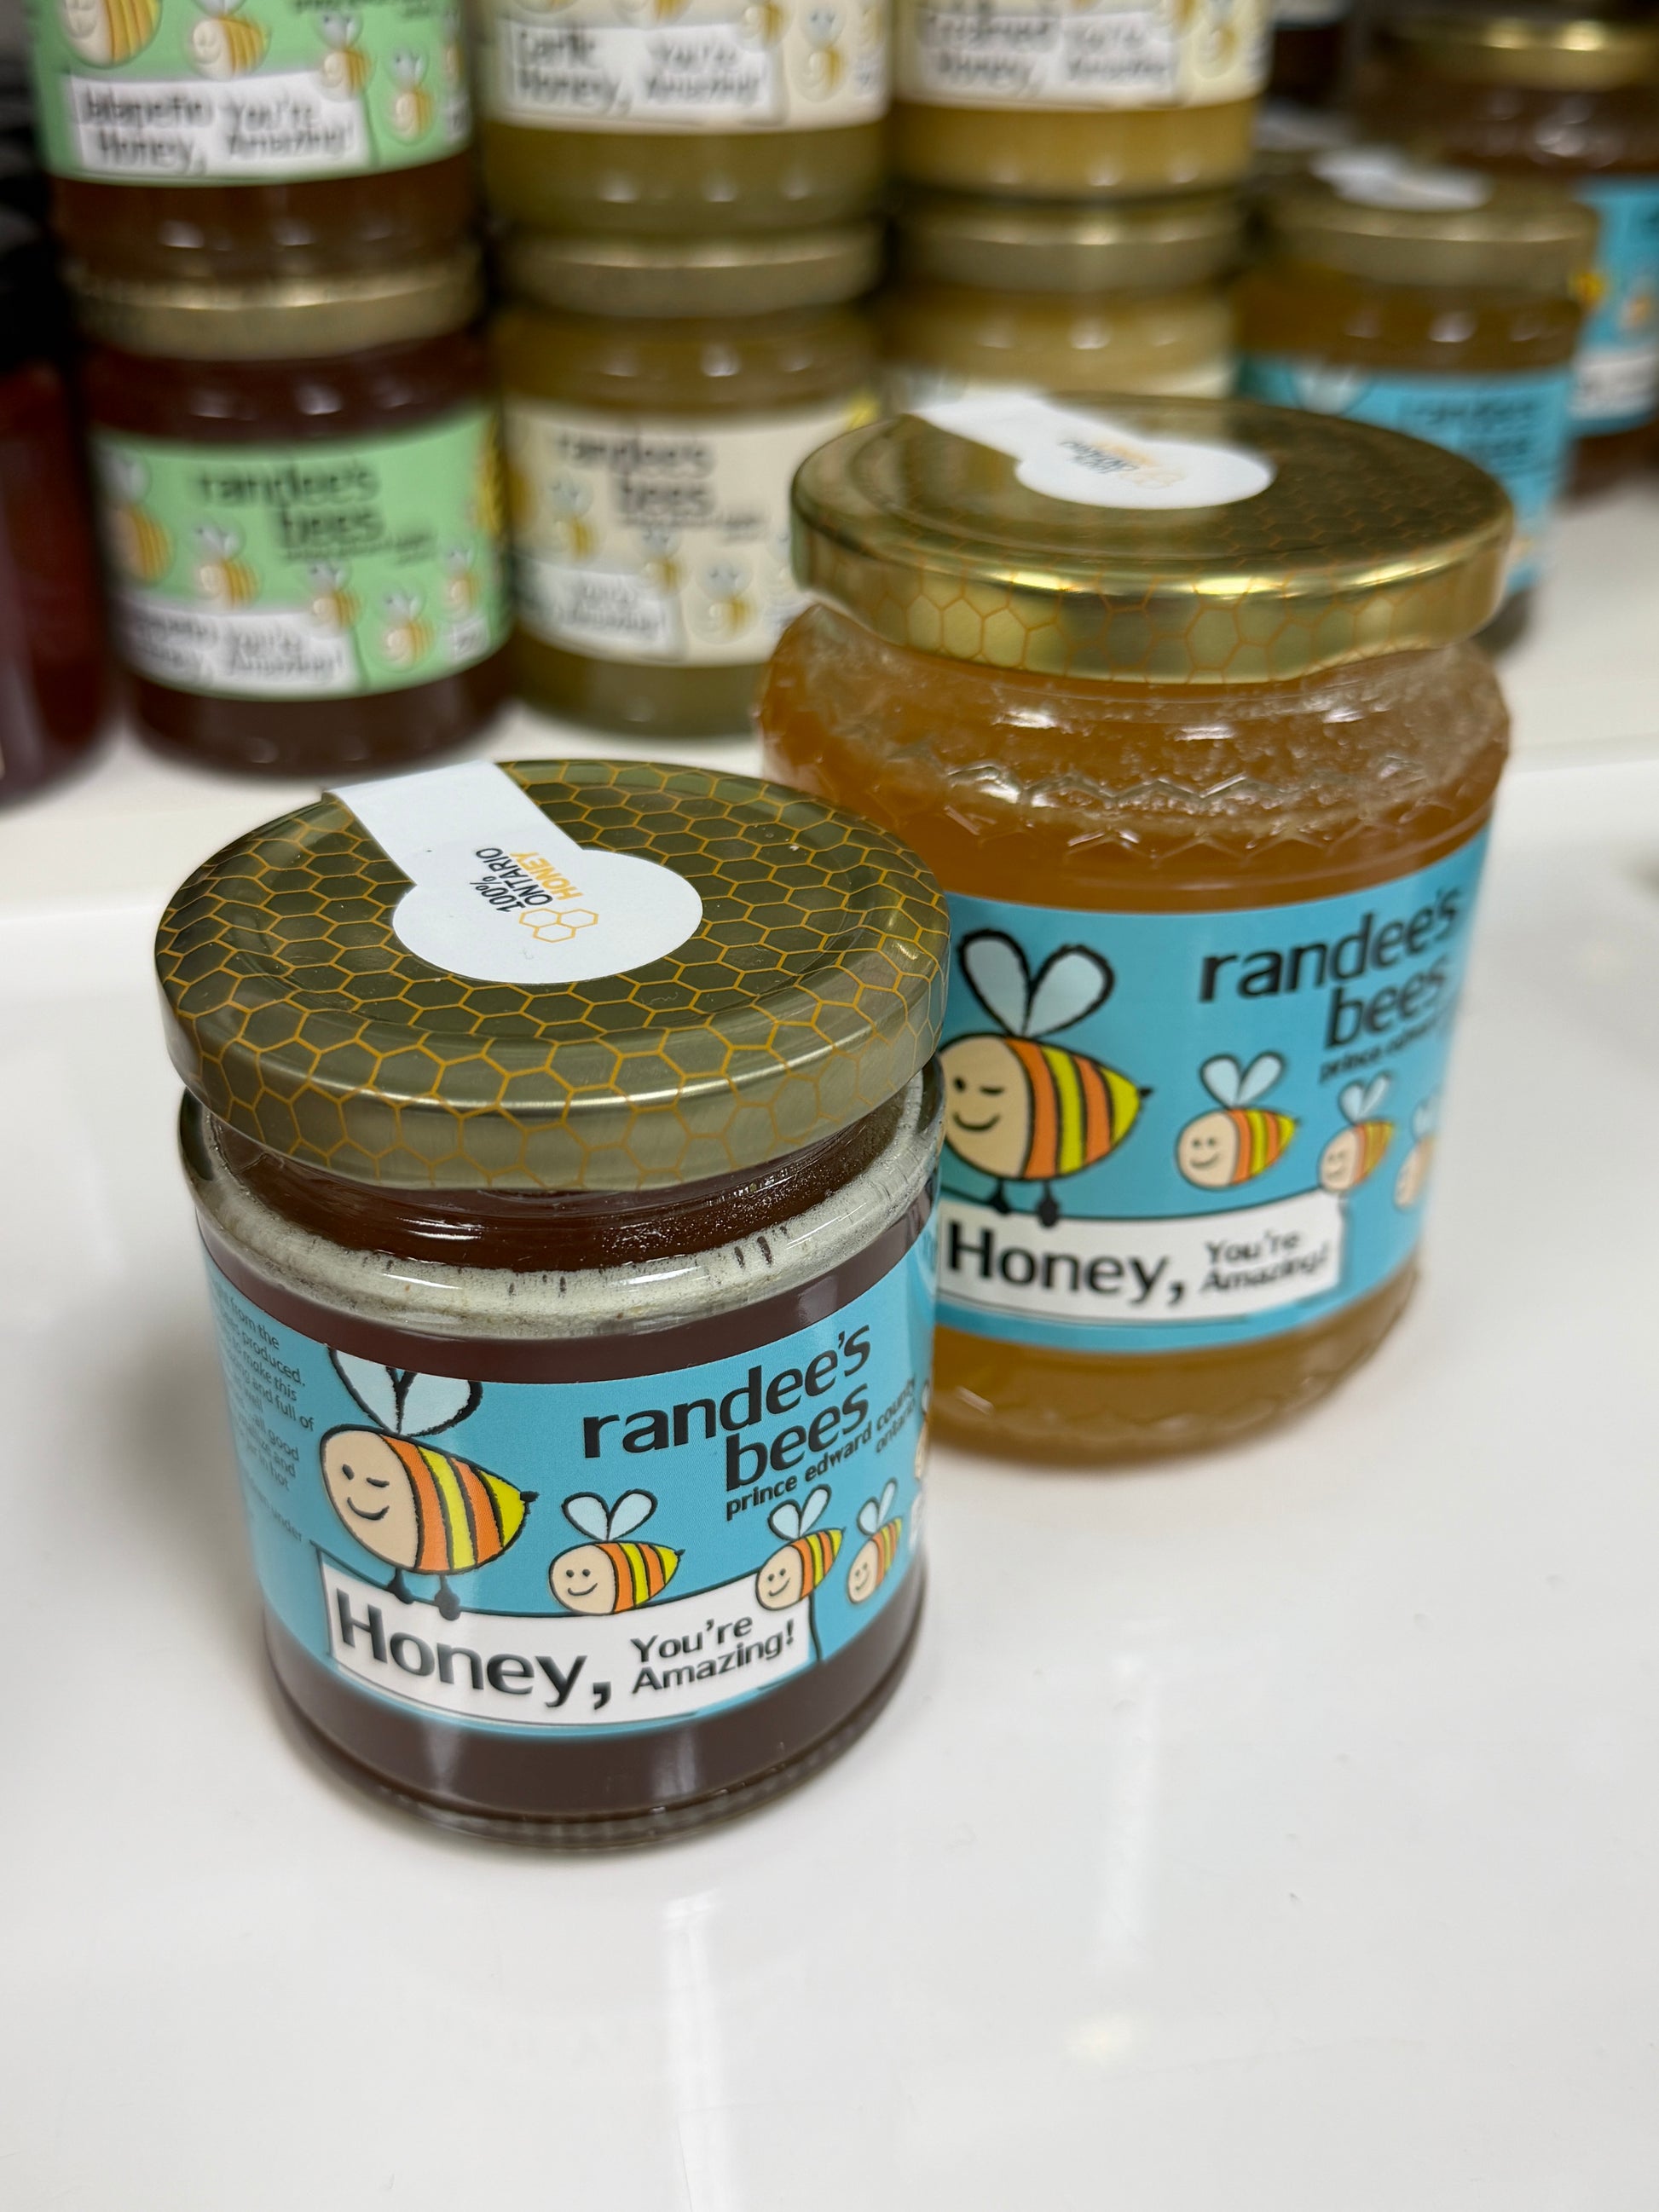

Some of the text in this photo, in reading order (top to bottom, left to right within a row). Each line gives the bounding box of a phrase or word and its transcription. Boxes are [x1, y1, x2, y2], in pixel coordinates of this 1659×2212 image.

[469, 875, 526, 912] 100%
[476, 847, 553, 906] ONTARIO
[509, 852, 584, 901] HONEY
[1199, 887, 1462, 1003] randee's
[1324, 954, 1448, 1049] bees
[947, 1219, 1186, 1308] Honey,
[1199, 1239, 1330, 1292] Amazing!
[1205, 1228, 1301, 1264] You're
[242, 1331, 306, 1387] produced.
[257, 1323, 280, 1350] the
[274, 1376, 298, 1403] this
[275, 1394, 297, 1422] full
[299, 1415, 315, 1433] of
[583, 1325, 871, 1459] randee's
[268, 1429, 300, 1462] good
[725, 1383, 869, 1492] bees
[726, 1475, 798, 1522] prince
[805, 1421, 872, 1482] edward
[336, 1587, 612, 1711] Honey,
[630, 1614, 753, 1664] You're
[632, 1620, 795, 1695] Amazing!
